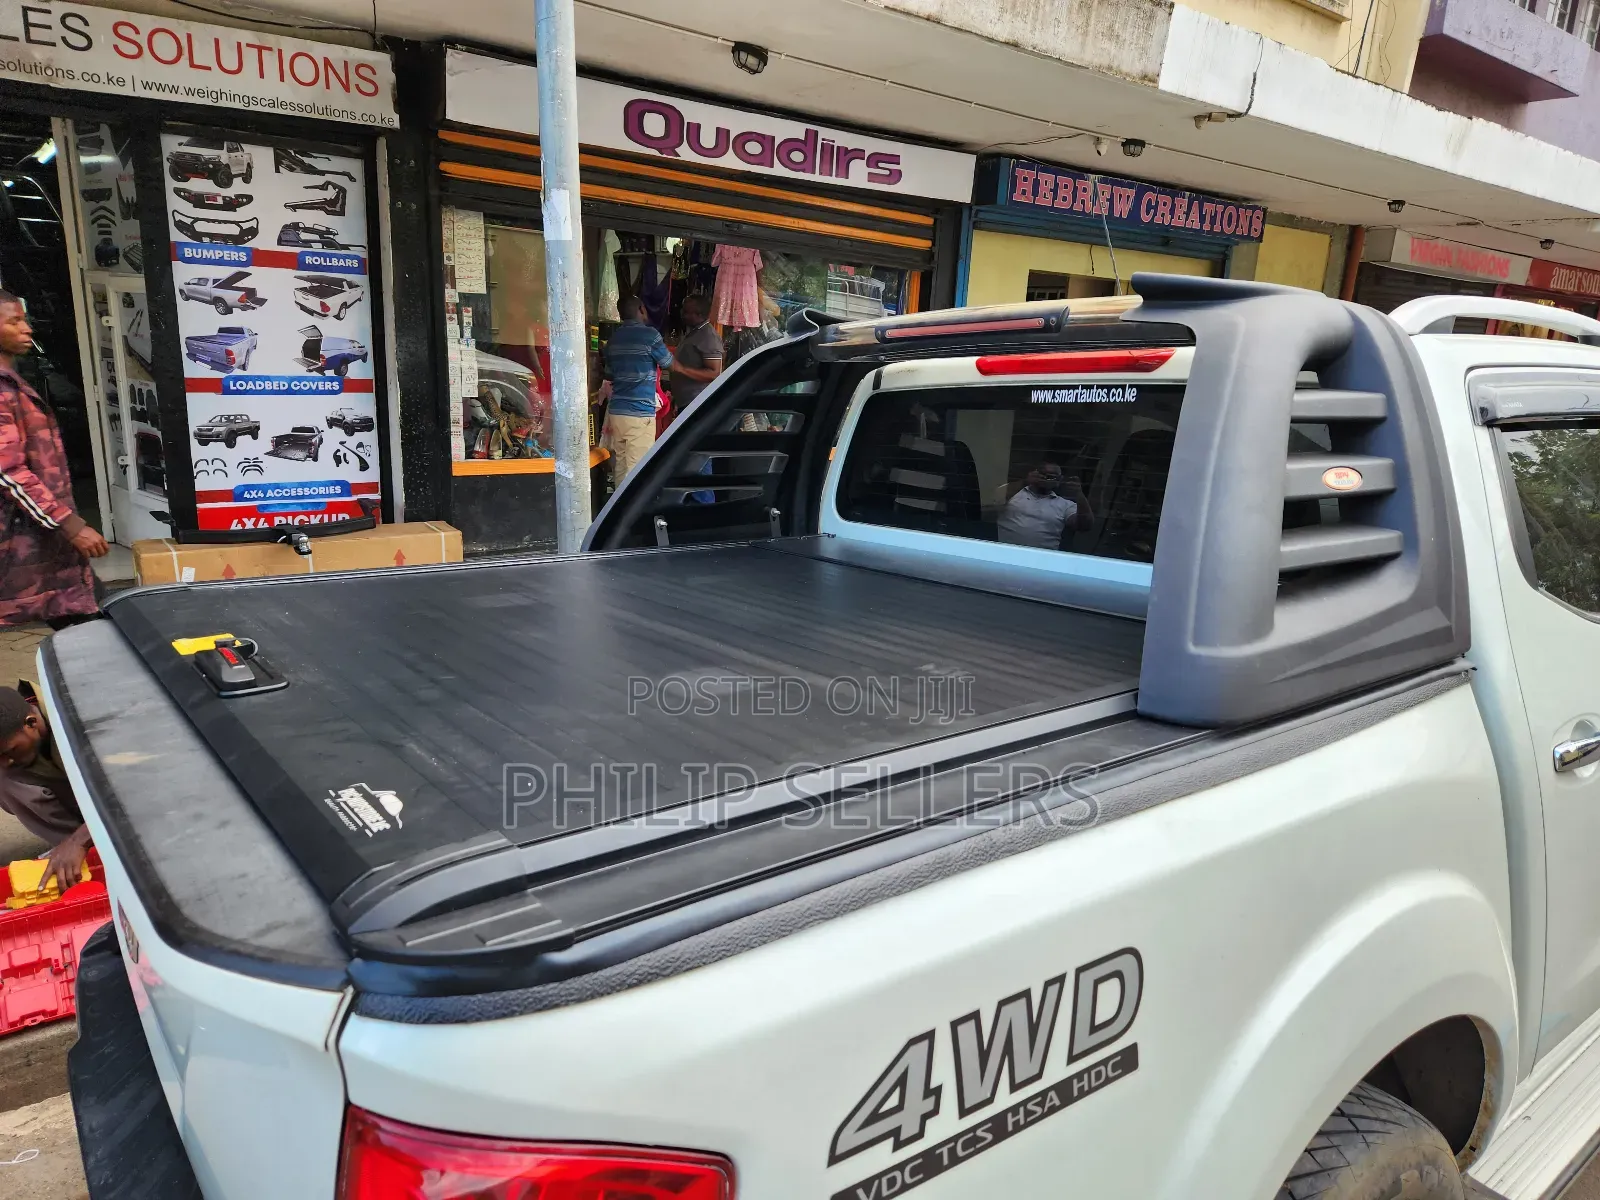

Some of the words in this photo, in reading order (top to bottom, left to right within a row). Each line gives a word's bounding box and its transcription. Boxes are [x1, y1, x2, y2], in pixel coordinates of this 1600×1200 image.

[112, 20, 380, 98] SOLUTIONS
[141, 79, 395, 127] www.weighingscalessolutions.co.ke
[623, 98, 903, 185] Quadirs
[1012, 168, 1136, 219] HEBREW
[1140, 191, 1265, 238] CREATIONS
[184, 247, 247, 261] BUMPERS
[305, 255, 359, 268] ROLLBARS
[229, 379, 288, 391] LOADBED
[291, 380, 340, 391] COVERS
[1031, 384, 1137, 403] www.smartautos.co.ke
[243, 489, 264, 499] 4X4
[266, 486, 341, 497] ACCESSORIES
[230, 517, 269, 530] 4X4
[827, 946, 1144, 1168] 4WD
[856, 1158, 924, 1200] VDC
[935, 1123, 994, 1166] TCS
[1007, 1090, 1061, 1132] HSA
[1072, 1055, 1122, 1098] HDC
